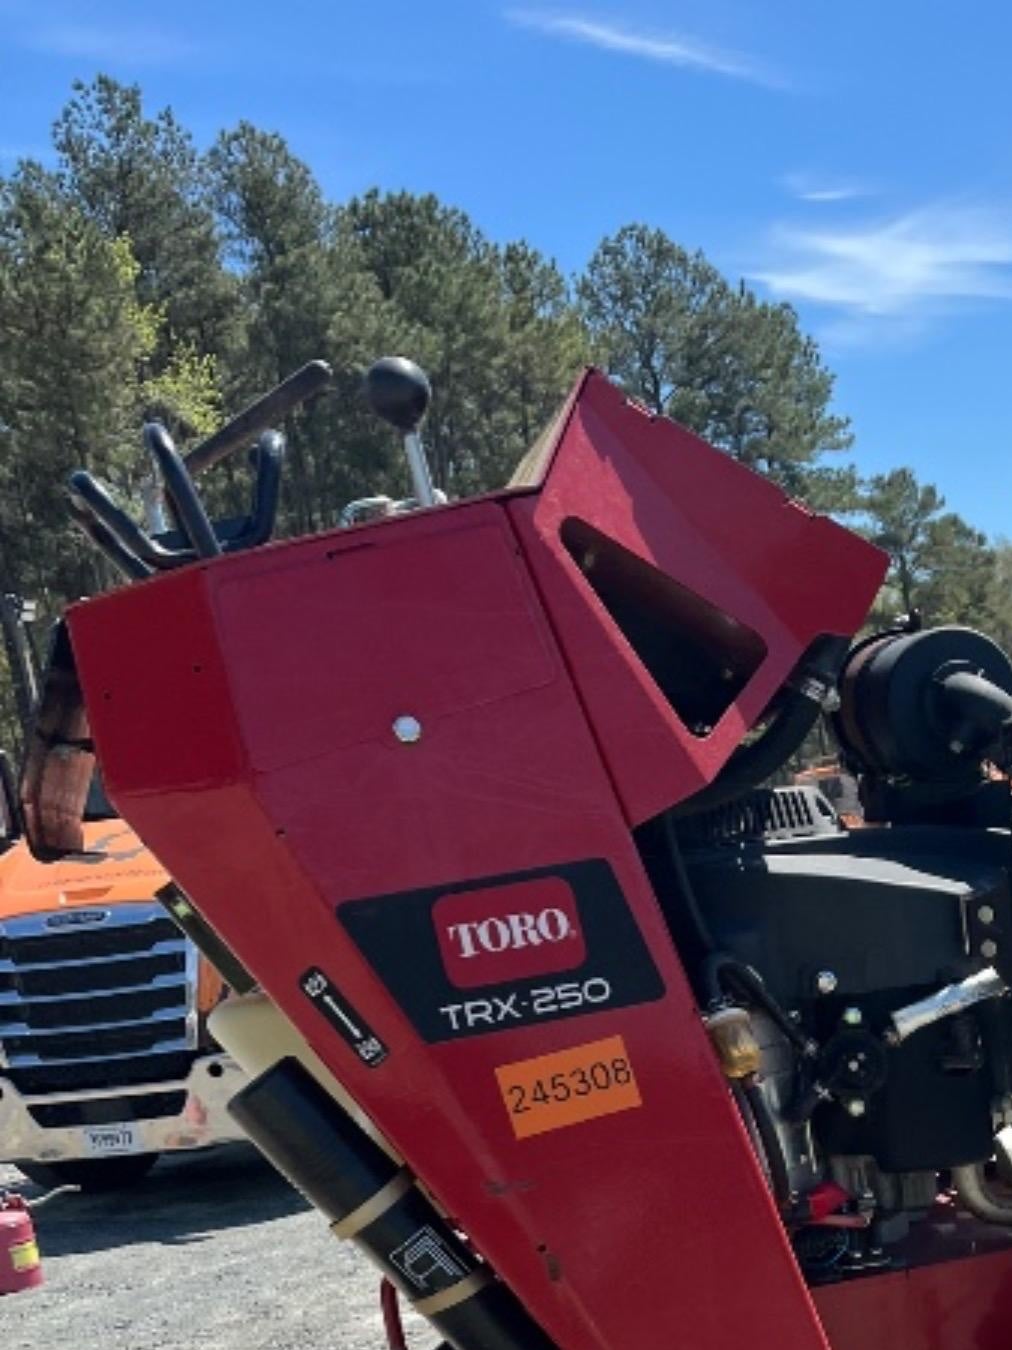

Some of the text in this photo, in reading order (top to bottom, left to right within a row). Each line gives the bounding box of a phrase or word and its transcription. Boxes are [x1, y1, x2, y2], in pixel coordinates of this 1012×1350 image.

[446, 908, 570, 958] TORO
[440, 977, 611, 1030] TRX-250
[507, 1058, 631, 1114] 245308
